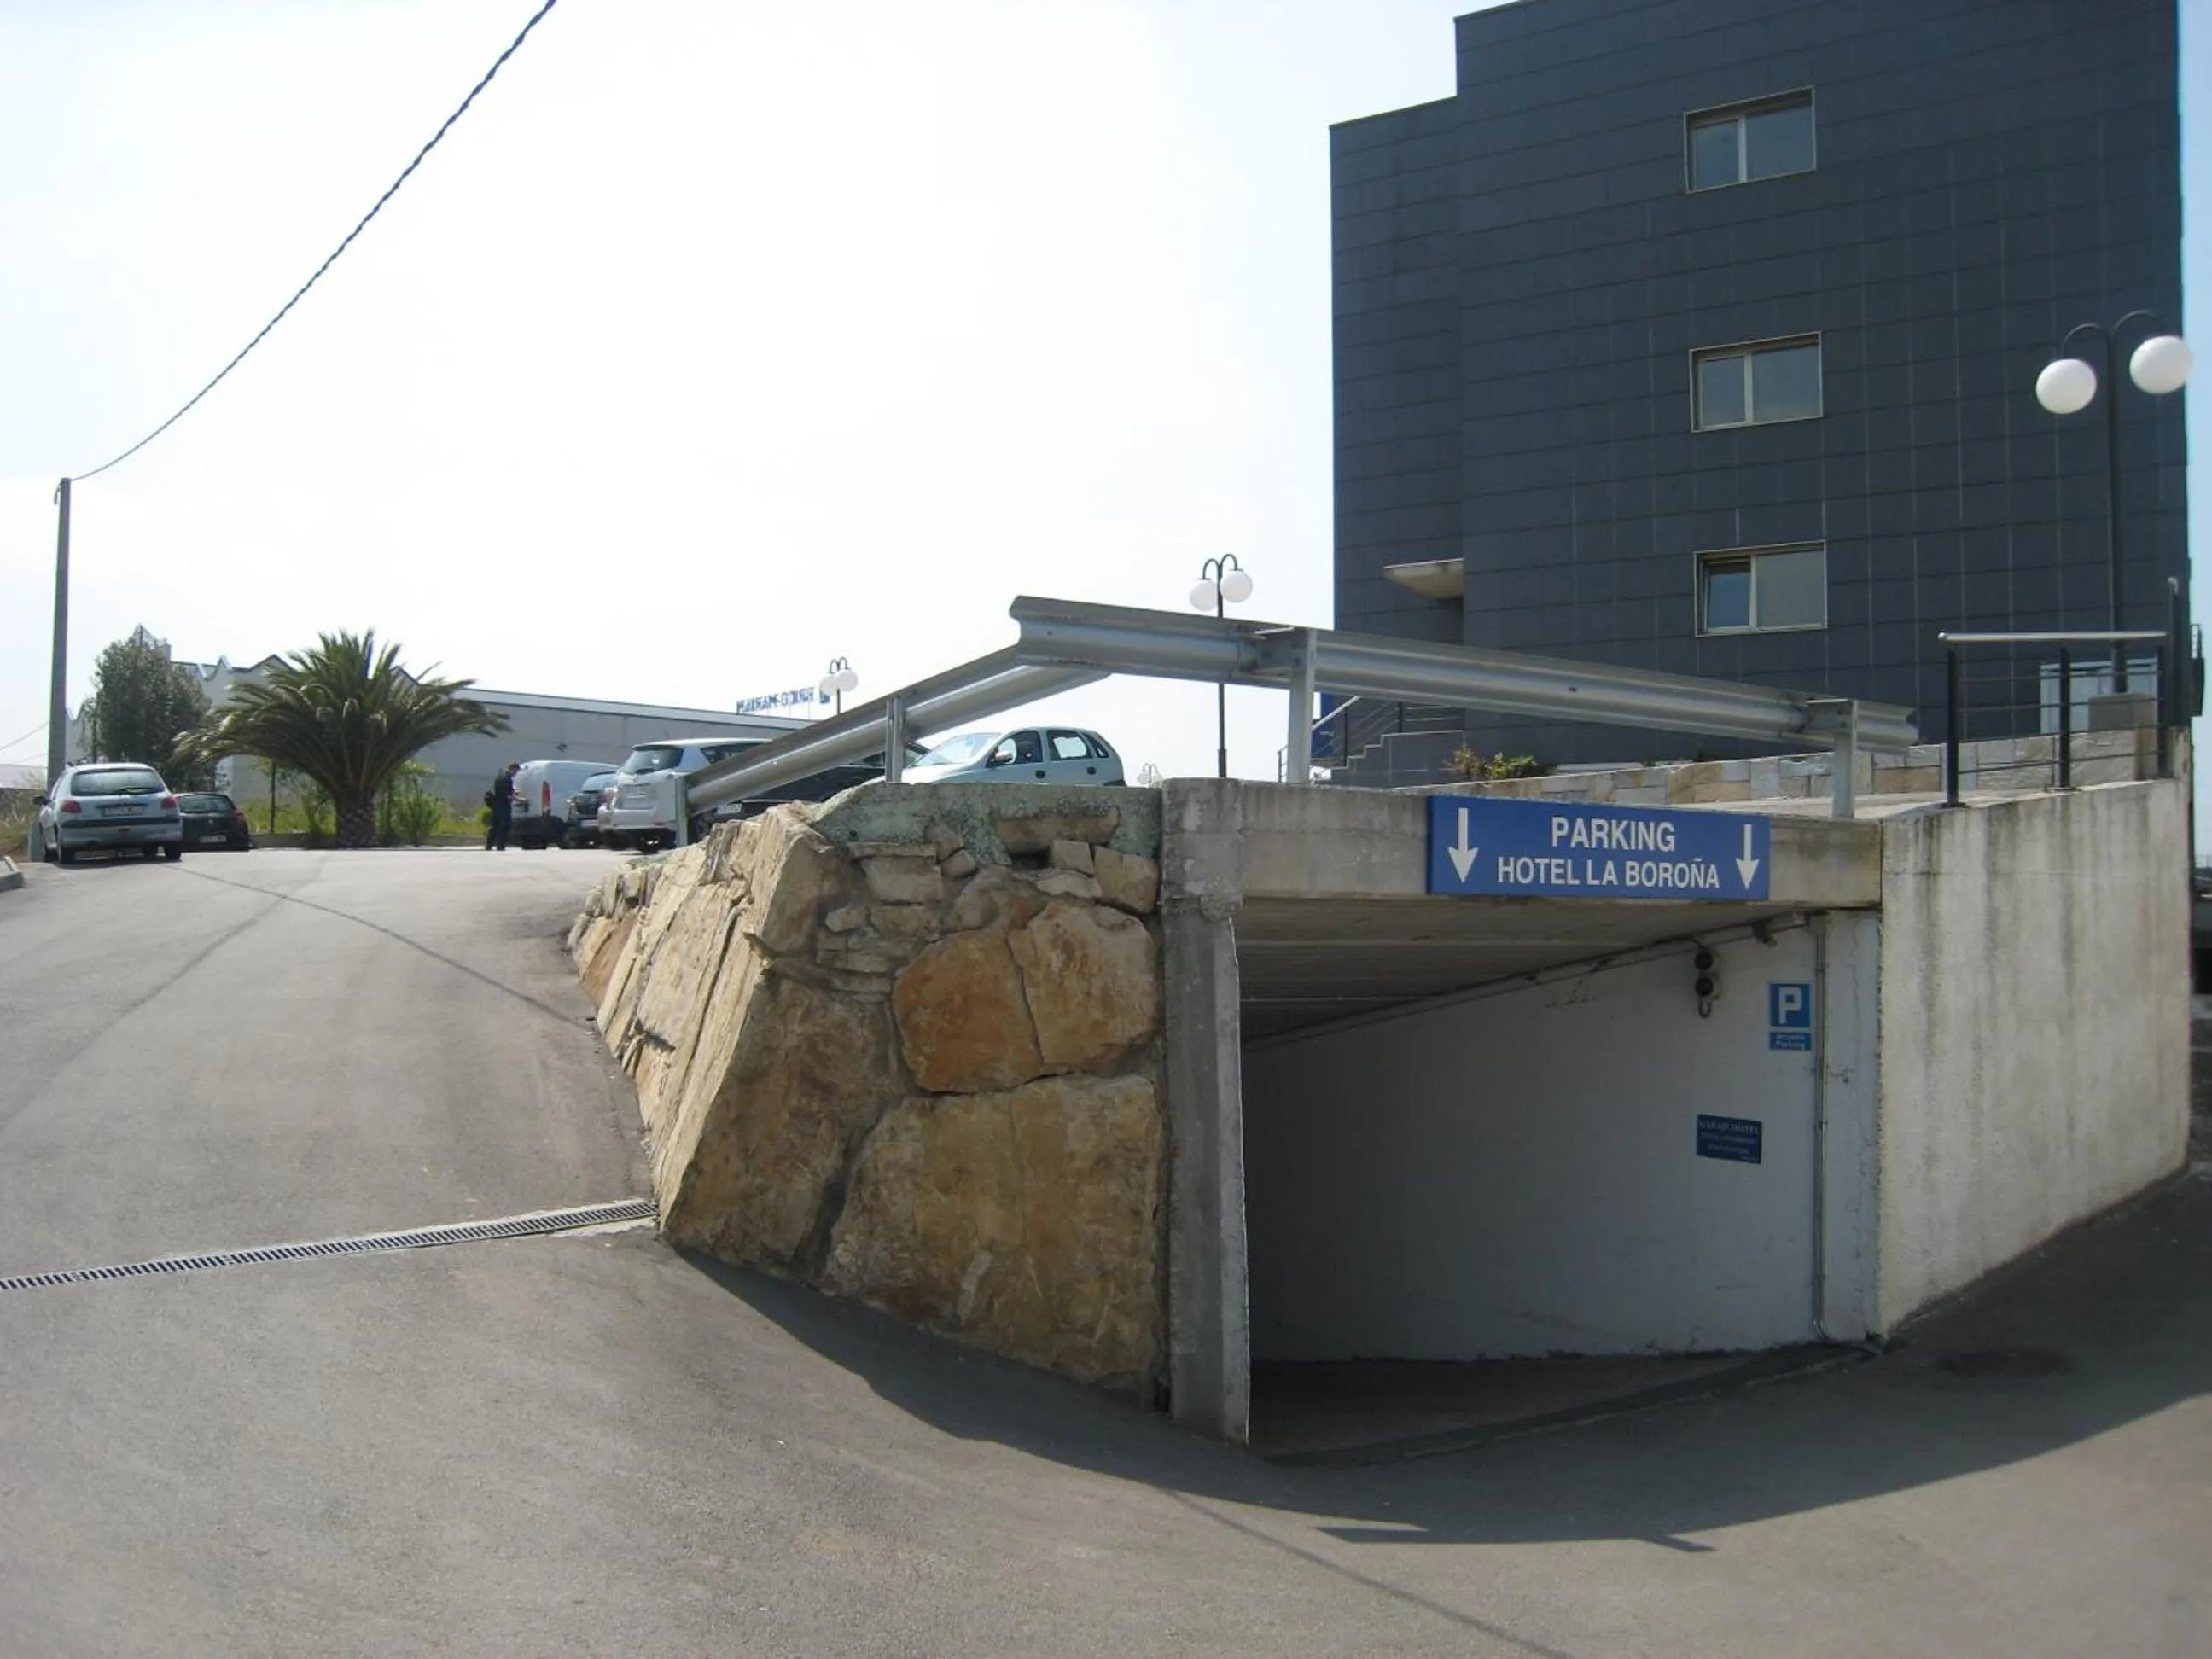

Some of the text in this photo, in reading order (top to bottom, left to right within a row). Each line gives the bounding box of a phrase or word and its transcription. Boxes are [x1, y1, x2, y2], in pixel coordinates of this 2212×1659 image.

[1551, 816, 1675, 852] PARKING
[1498, 856, 1720, 889] HOTEL LA BOROÑA
[1778, 987, 1802, 1024] P
